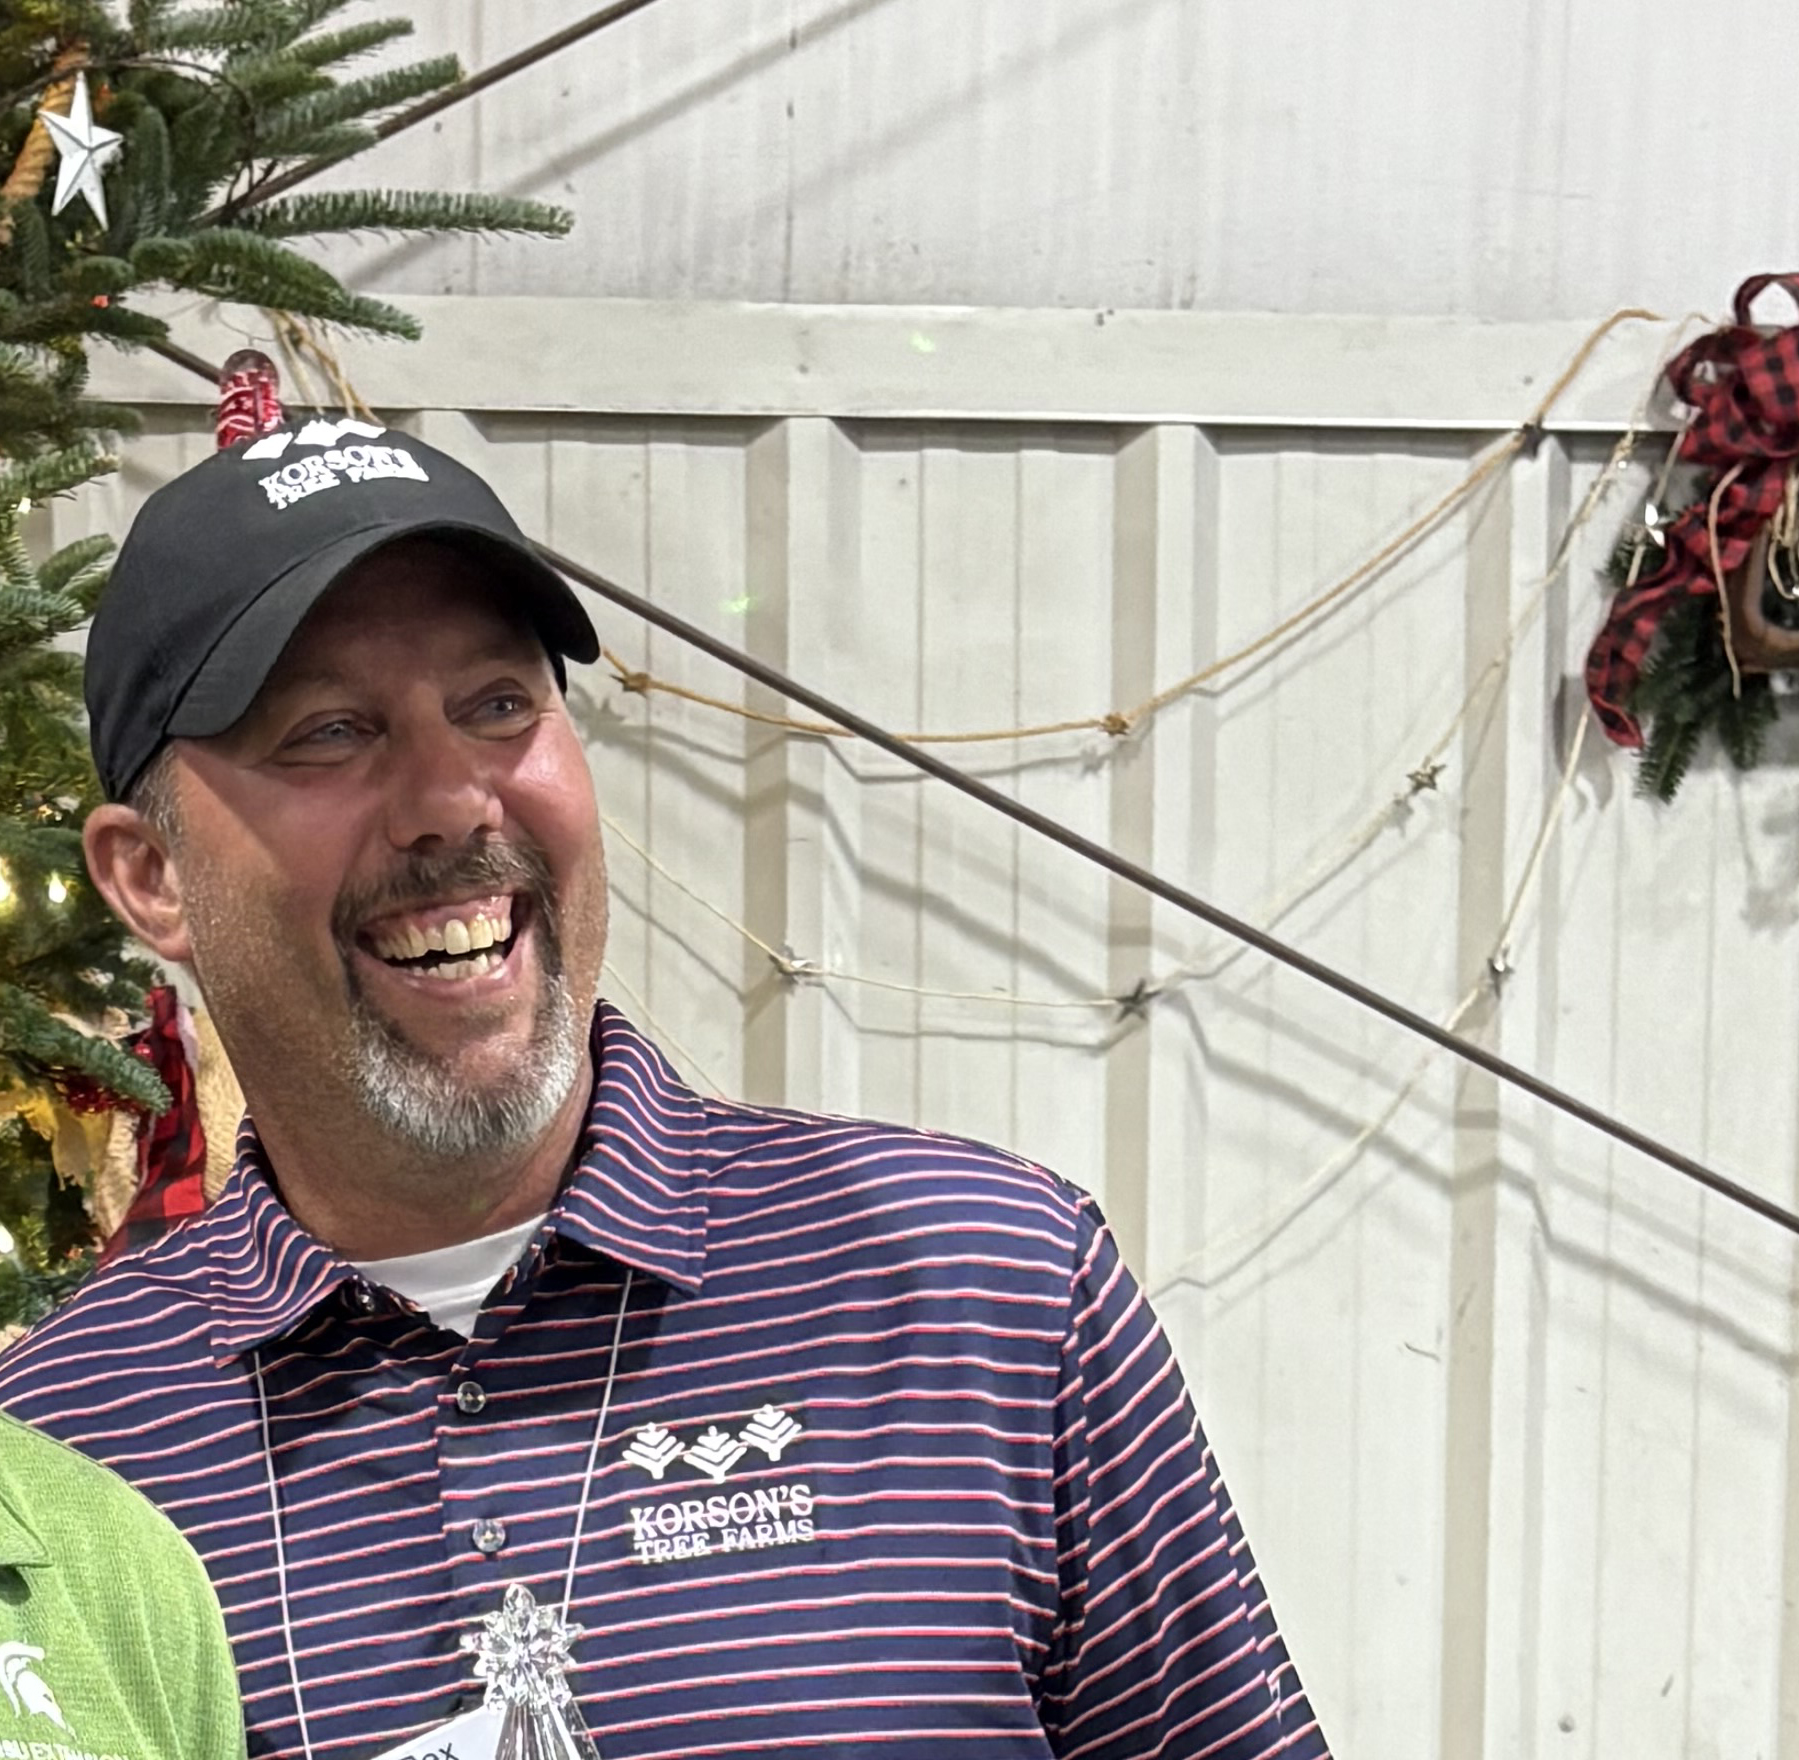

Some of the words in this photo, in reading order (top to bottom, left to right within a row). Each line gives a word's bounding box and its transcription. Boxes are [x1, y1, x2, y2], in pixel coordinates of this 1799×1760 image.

[630, 1484, 813, 1541] KORSON'S
[634, 1533, 712, 1564] TREE
[721, 1519, 814, 1552] FARMS
